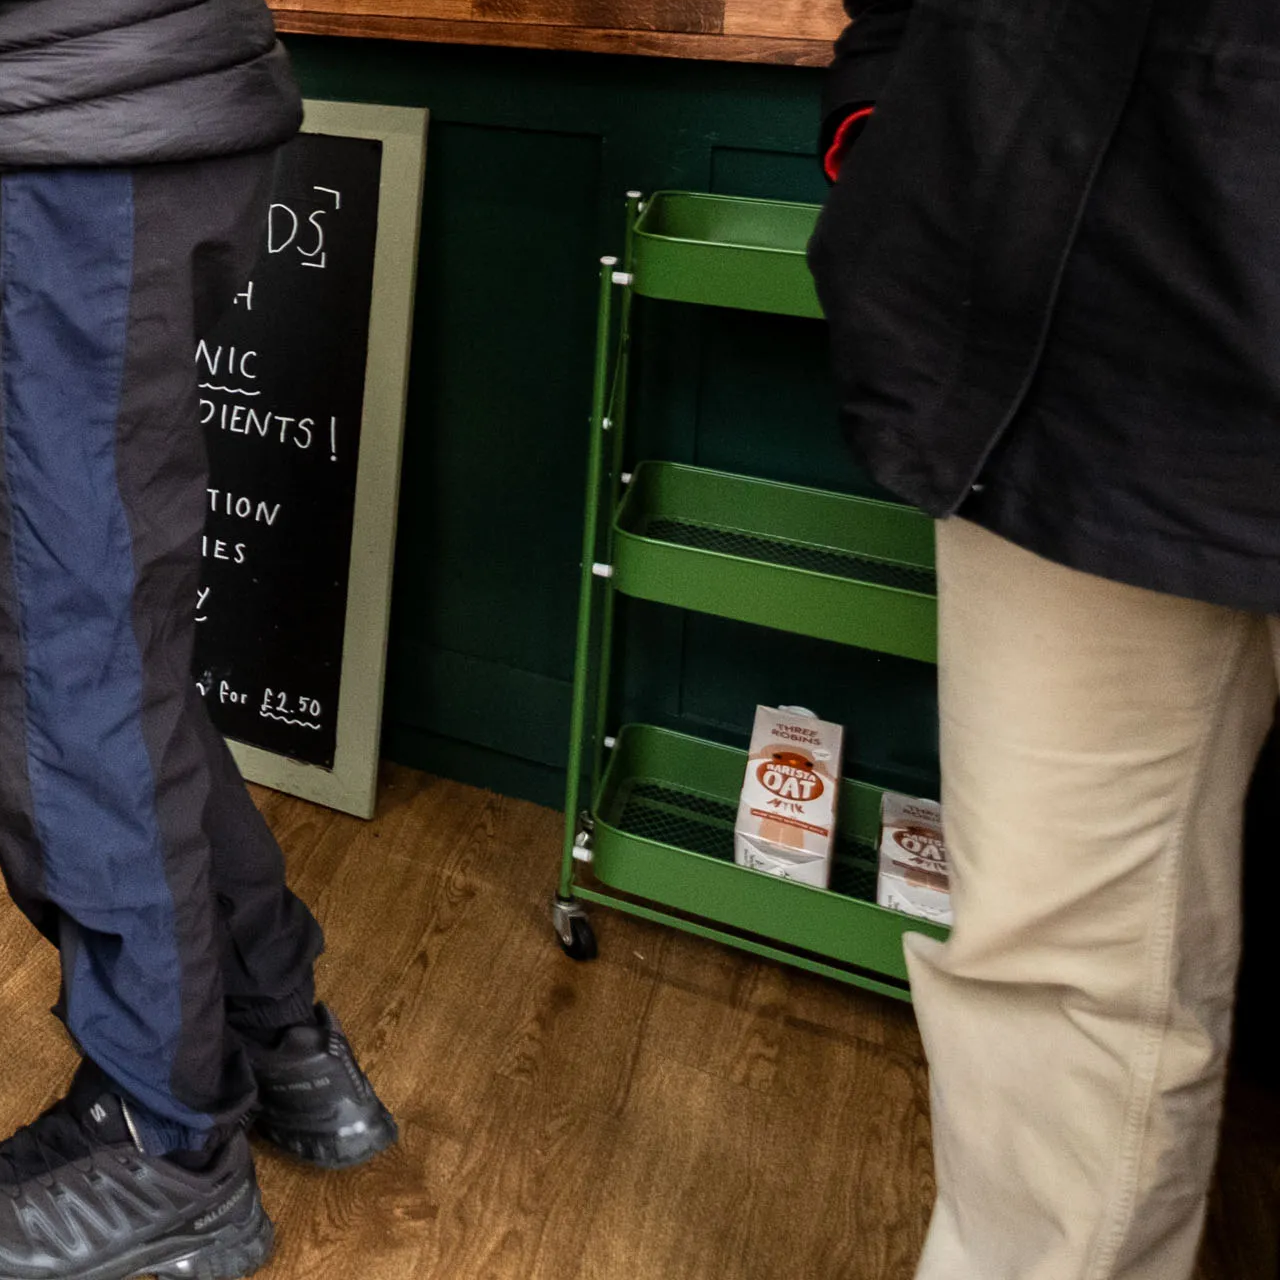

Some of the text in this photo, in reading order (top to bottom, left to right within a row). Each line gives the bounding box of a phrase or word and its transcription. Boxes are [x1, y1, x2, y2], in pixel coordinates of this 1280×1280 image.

[195, 339, 257, 379] NIC
[206, 487, 281, 526] TION
[202, 535, 246, 564] IES
[220, 680, 248, 704] for
[260, 687, 321, 717] £2.50
[771, 728, 822, 746] ROBINS
[776, 723, 818, 738] THREE
[762, 770, 816, 801] OAT
[766, 763, 817, 782] BARISTA
